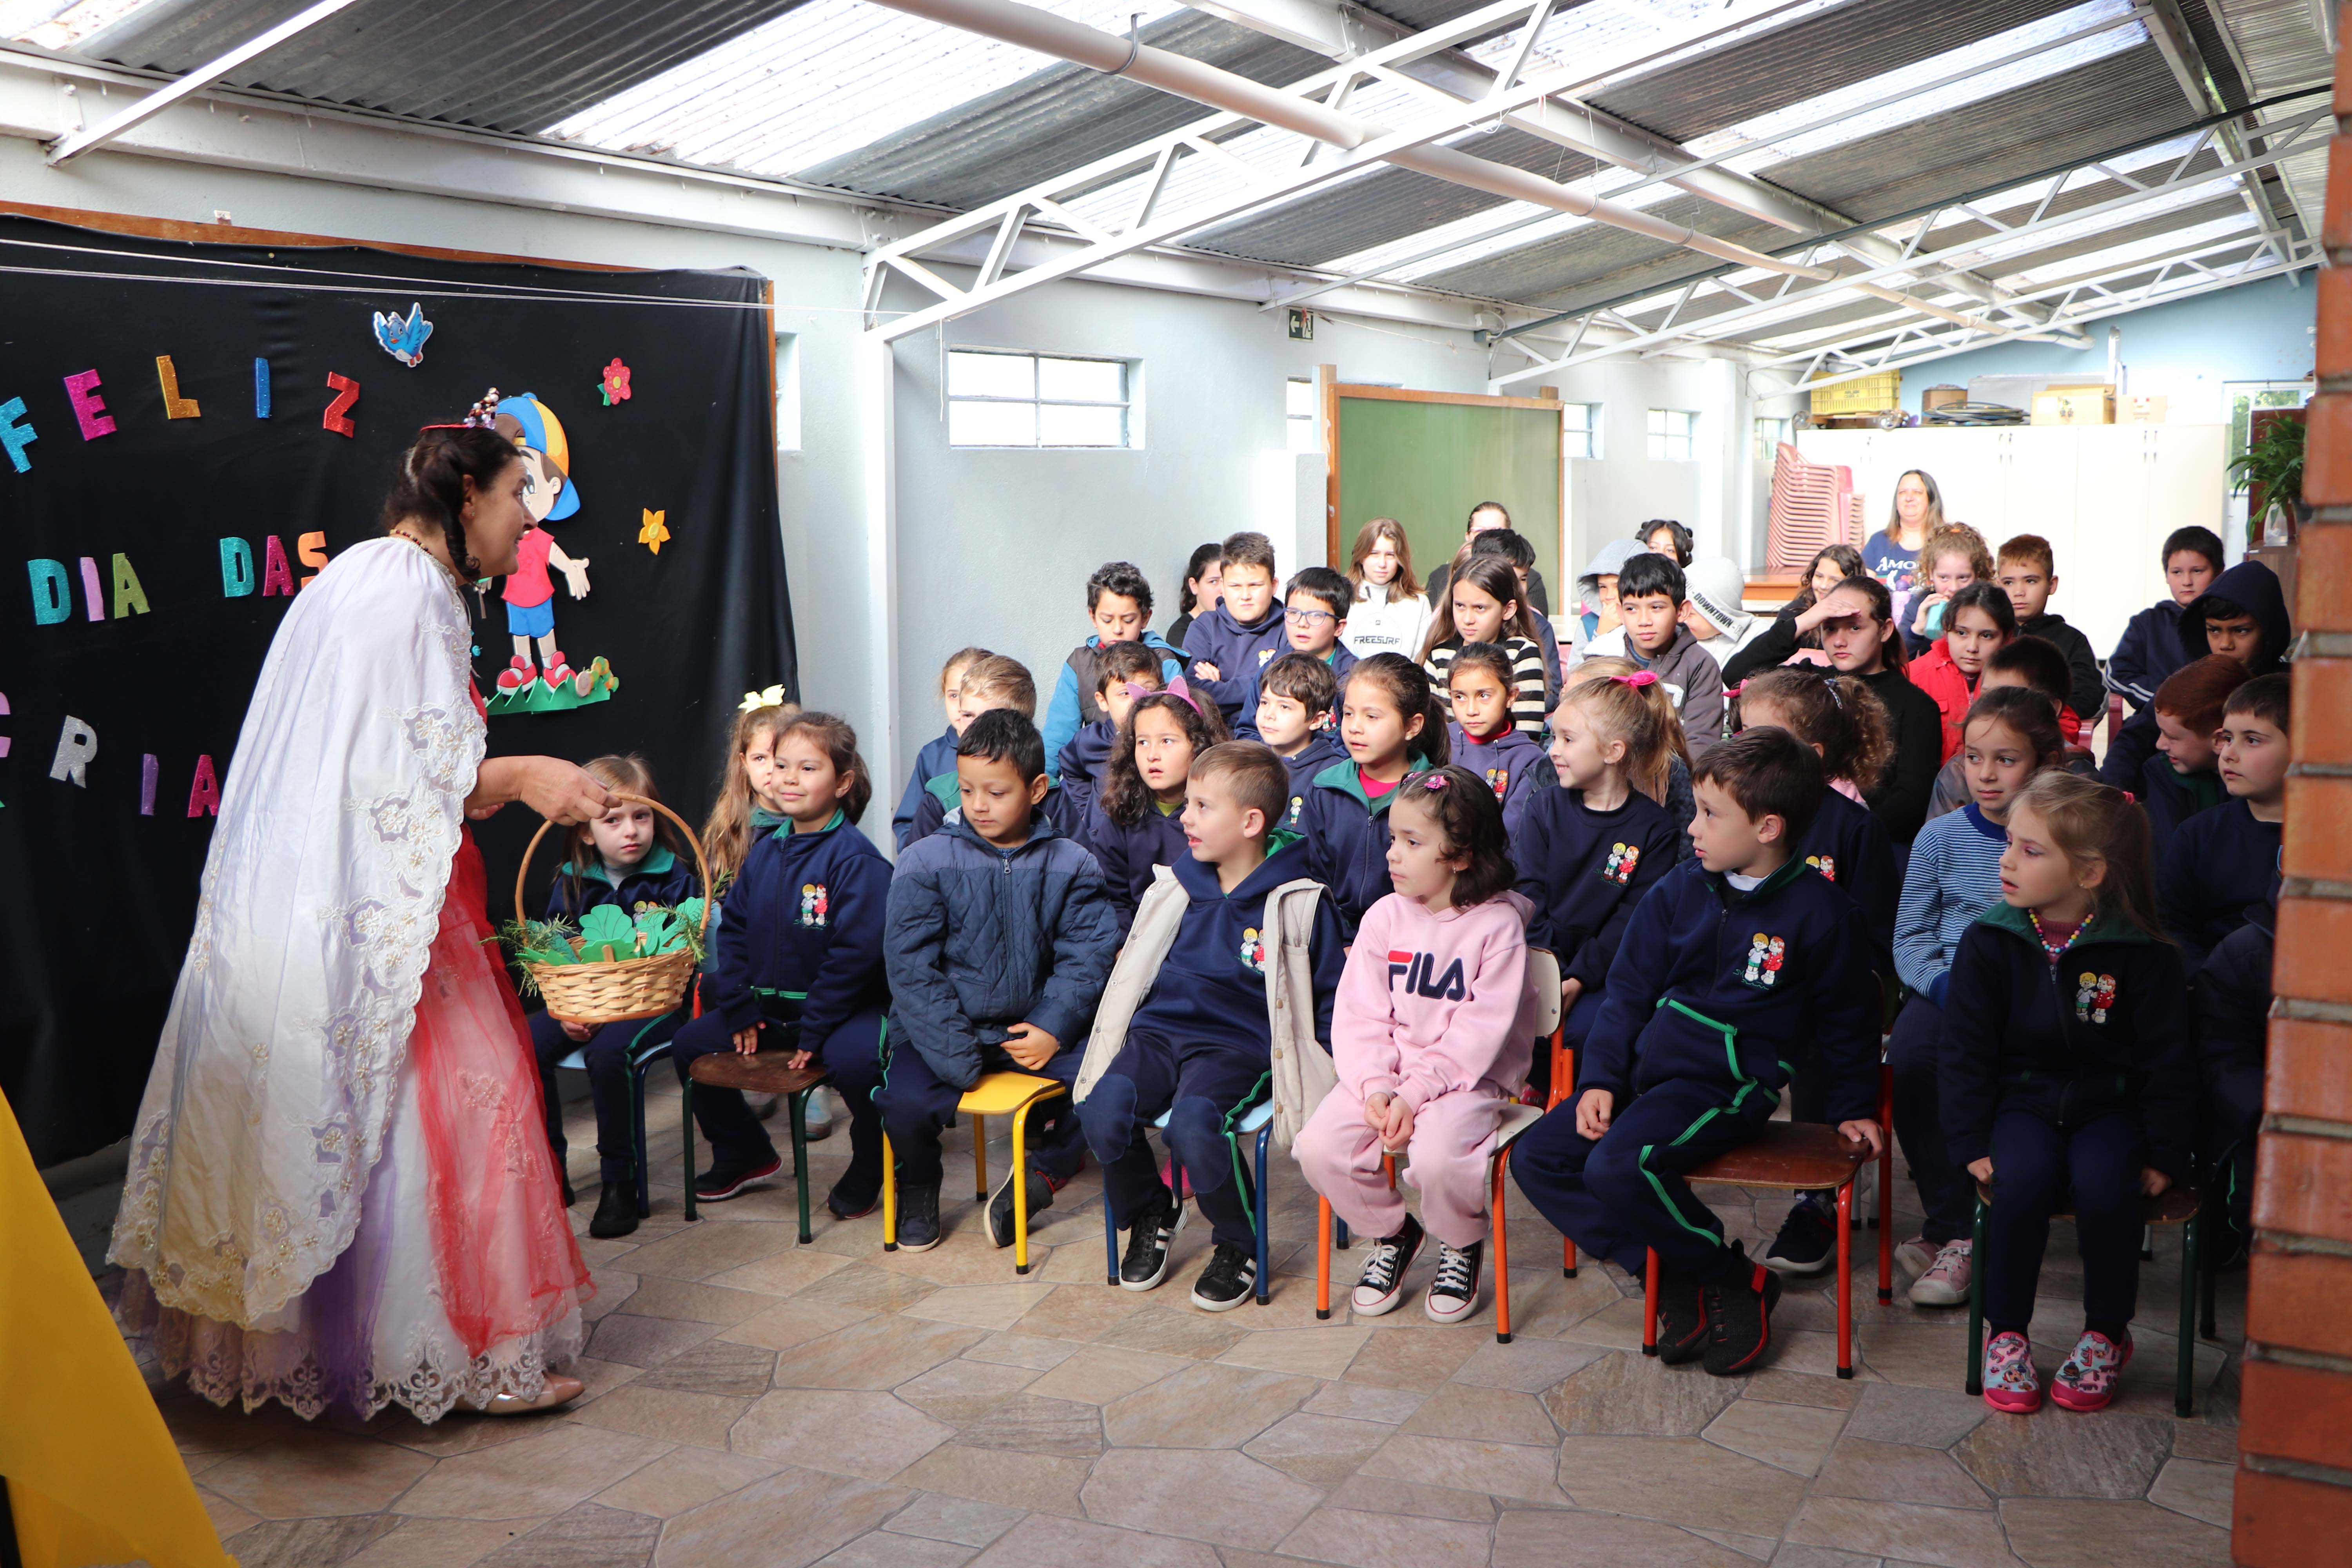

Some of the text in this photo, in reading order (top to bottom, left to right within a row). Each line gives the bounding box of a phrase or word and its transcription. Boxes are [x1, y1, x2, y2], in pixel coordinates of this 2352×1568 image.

[0, 354, 360, 473] FELIZ
[27, 531, 328, 625] DIA DAS
[1875, 556, 1919, 571] AMO
[1693, 592, 1734, 628] DOWNTOWN
[1354, 635, 1400, 645] FREESURF
[1388, 950, 1466, 1002] FILA
